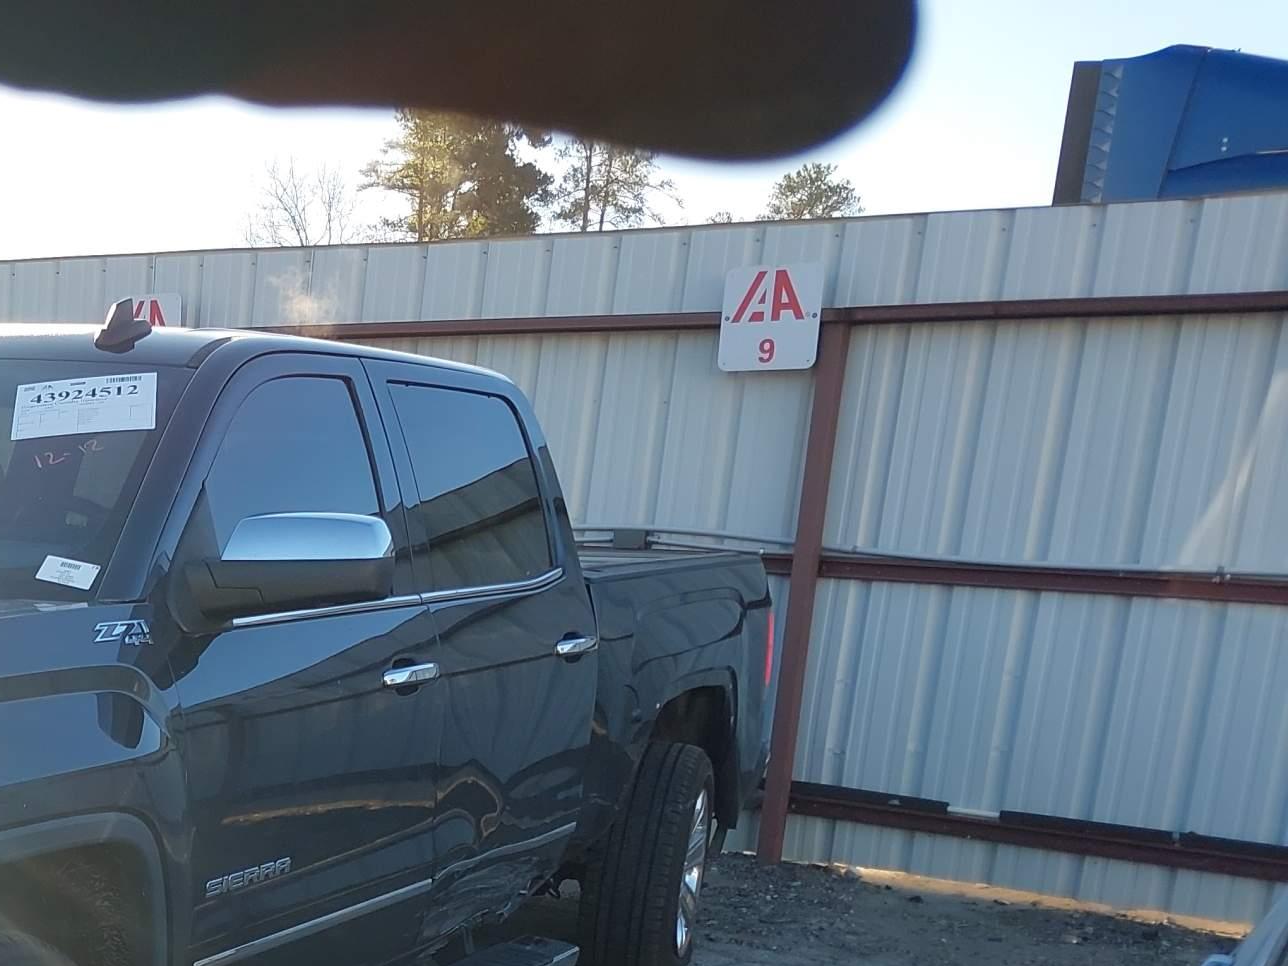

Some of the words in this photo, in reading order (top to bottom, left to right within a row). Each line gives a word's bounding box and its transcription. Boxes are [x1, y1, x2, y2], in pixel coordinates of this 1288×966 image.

[758, 338, 775, 363] 9
[30, 384, 139, 405] 43924512
[205, 856, 292, 898] SIERRA
